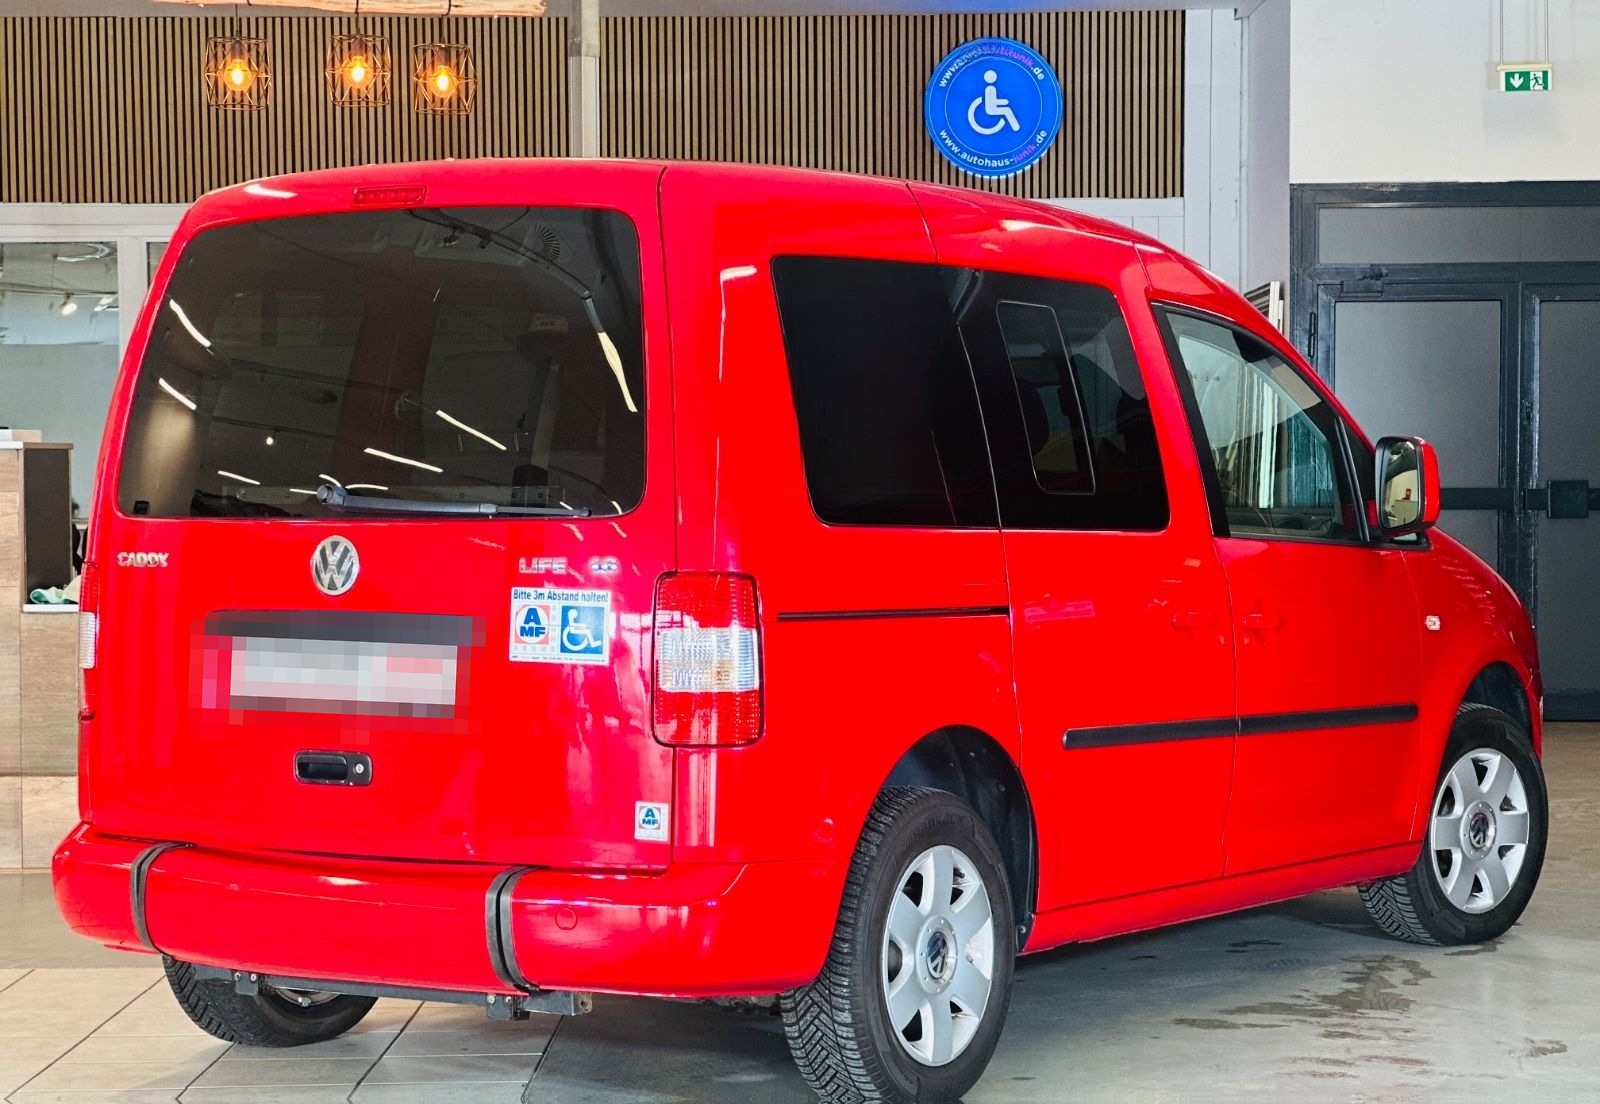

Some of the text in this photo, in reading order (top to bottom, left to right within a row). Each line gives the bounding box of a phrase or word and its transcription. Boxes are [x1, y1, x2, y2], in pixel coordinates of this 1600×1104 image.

[117, 551, 170, 568] CADDY
[519, 557, 567, 574] LIFE
[513, 589, 609, 603] Bitte 3m Abstand halten!
[523, 608, 541, 625] A
[519, 626, 546, 638] MF
